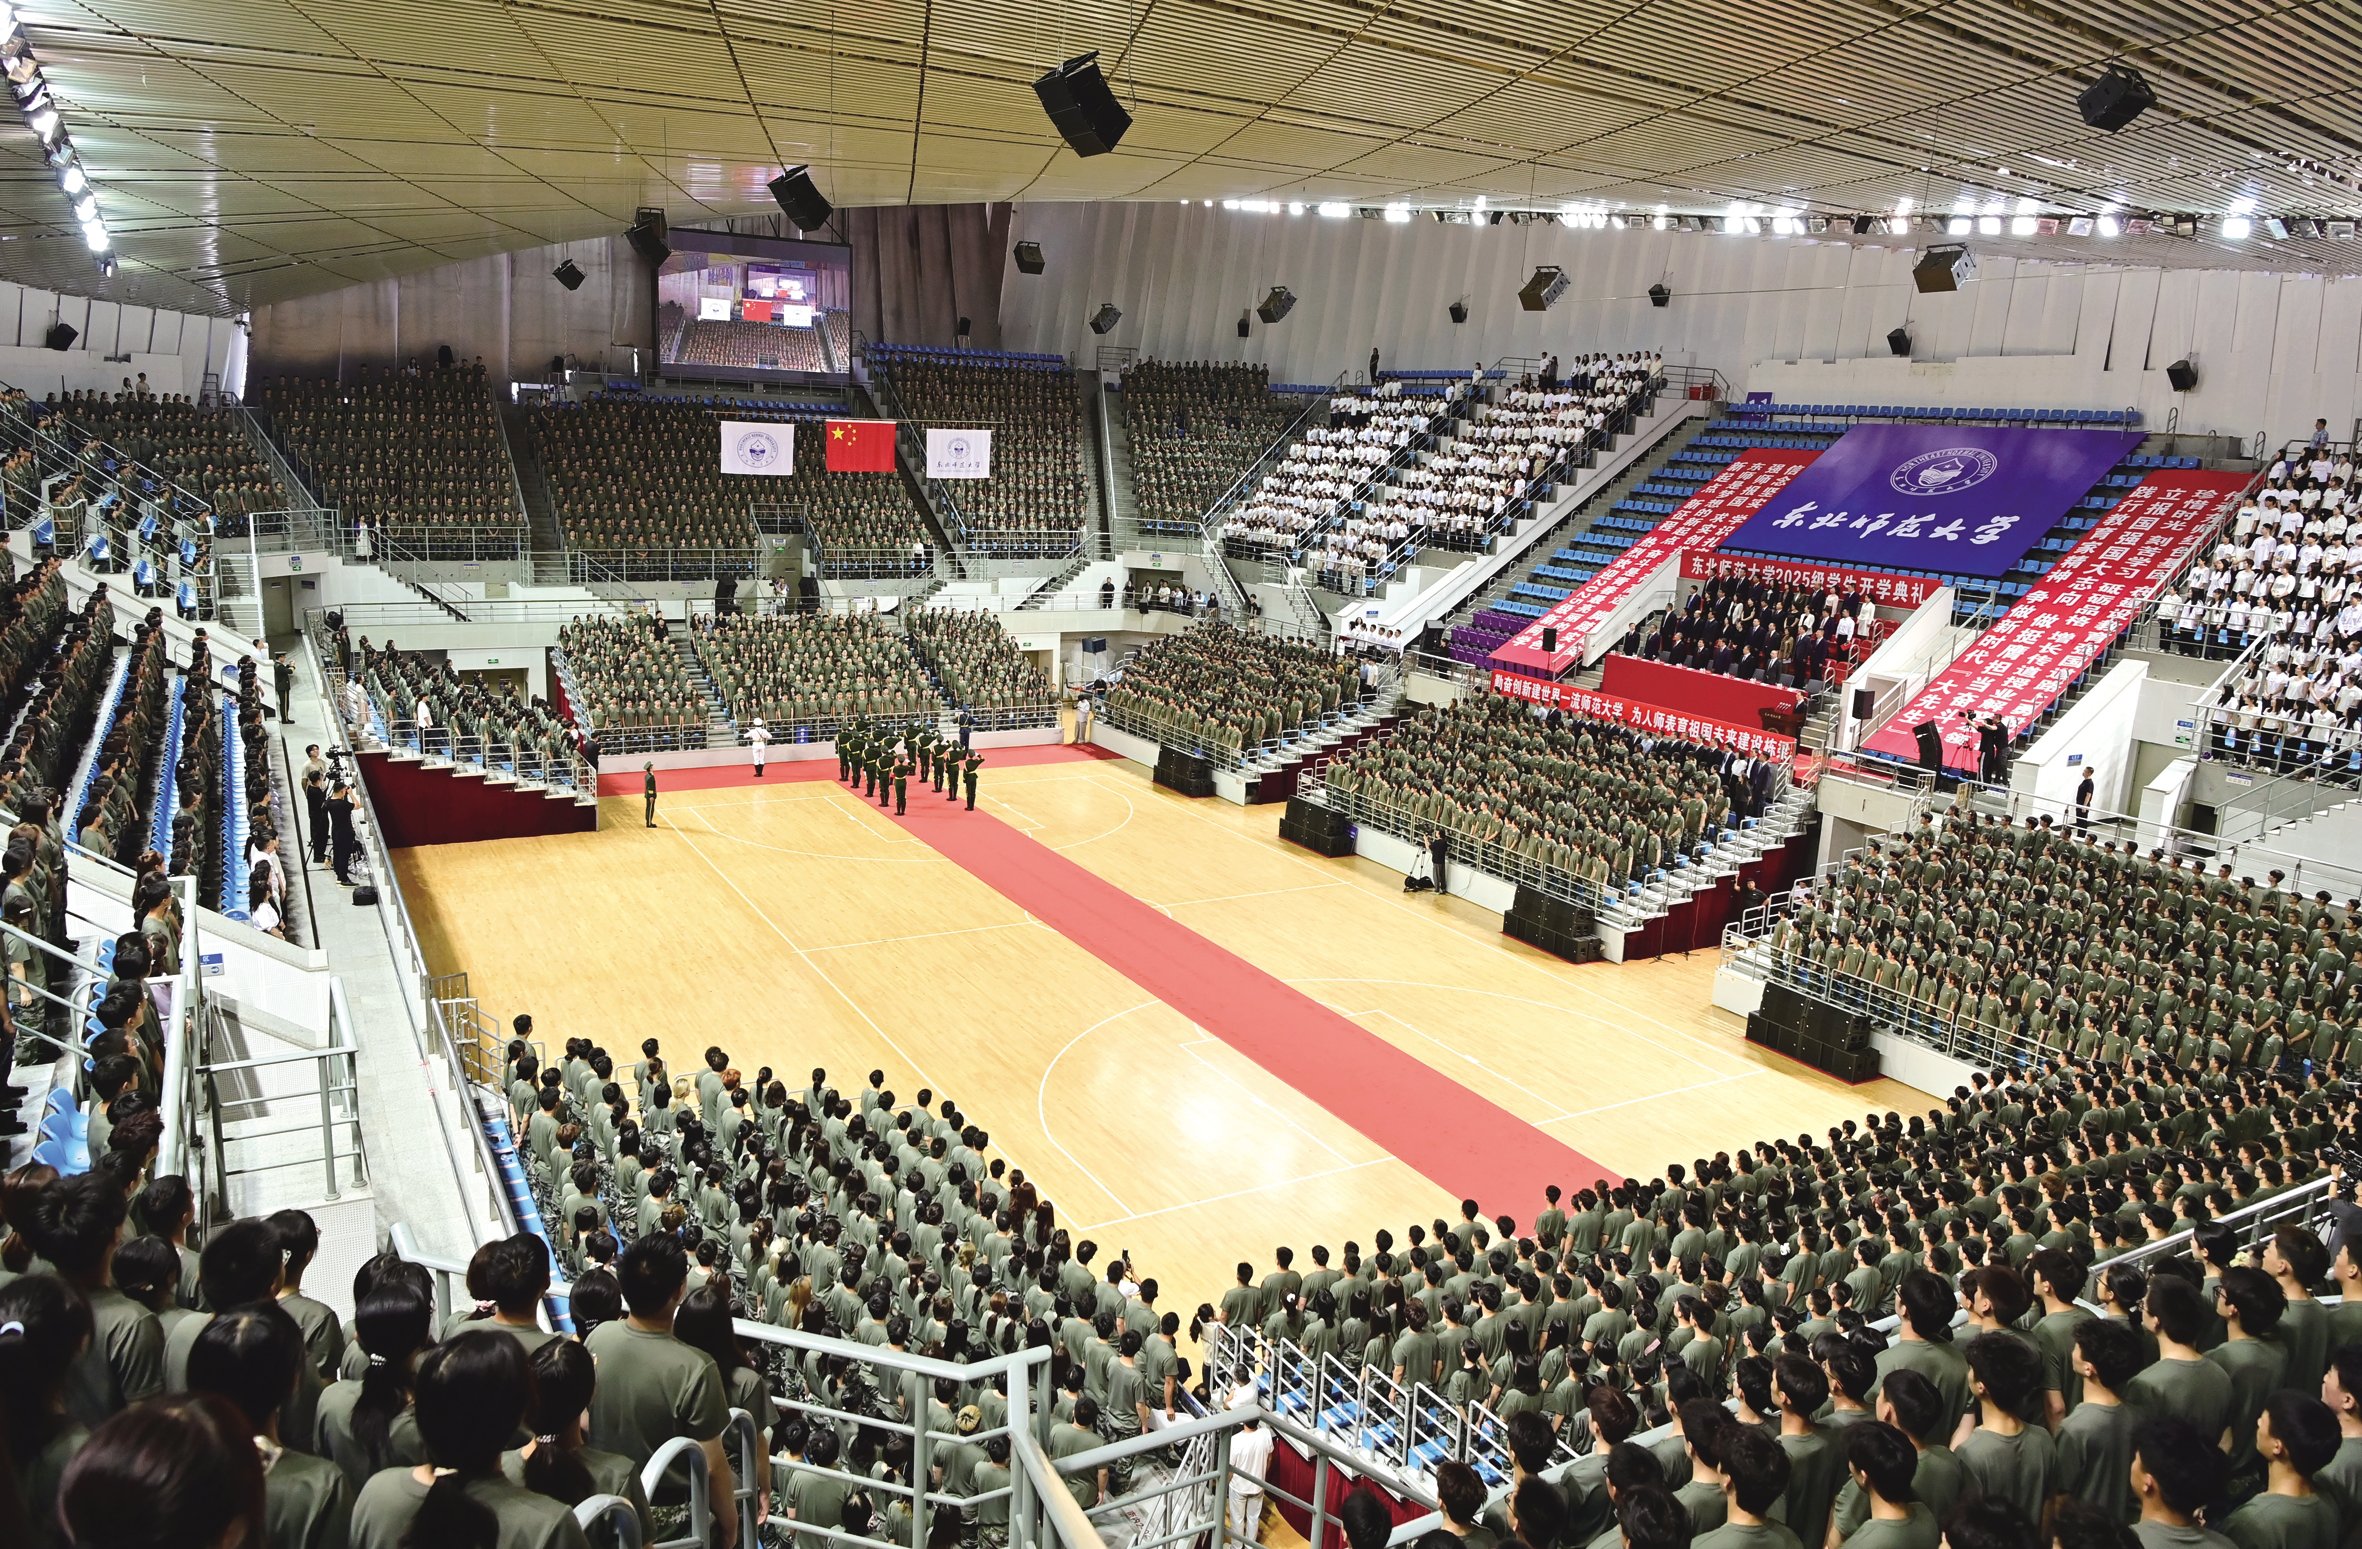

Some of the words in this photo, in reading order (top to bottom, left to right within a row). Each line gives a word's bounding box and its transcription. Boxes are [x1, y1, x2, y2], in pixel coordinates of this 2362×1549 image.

[1701, 461, 1748, 494] 新起点
[1727, 463, 1786, 507] 强师报国
[1746, 464, 1805, 509] 信念坚实
[1658, 499, 1704, 532] 新征程
[1661, 462, 1766, 545] 东师是梦想的新起点
[1772, 501, 2020, 545] 东北师范大学
[2160, 489, 2218, 532] 珍惜时光
[1694, 514, 1749, 552] 学识扎
[2045, 485, 2158, 584] 践行教育家精神
[2052, 488, 2187, 606] 立报国强国大志向
[1691, 556, 1926, 604] 东北师范大学2025级学生开学典礼
[2115, 535, 2174, 580] 刻苦学习
[1512, 536, 1657, 647] 热烈欢迎2025级新同学
[1528, 548, 1664, 650] 奋斗是青春最亮丽的色
[2065, 582, 2126, 628] 砥砺品格
[1932, 612, 2060, 733] 做挺膺担当奋斗
[1494, 673, 1624, 718] 勤奋创新建世界一流师范大学
[1630, 706, 1791, 760] 为人师表育祖国未来建设栋梁
